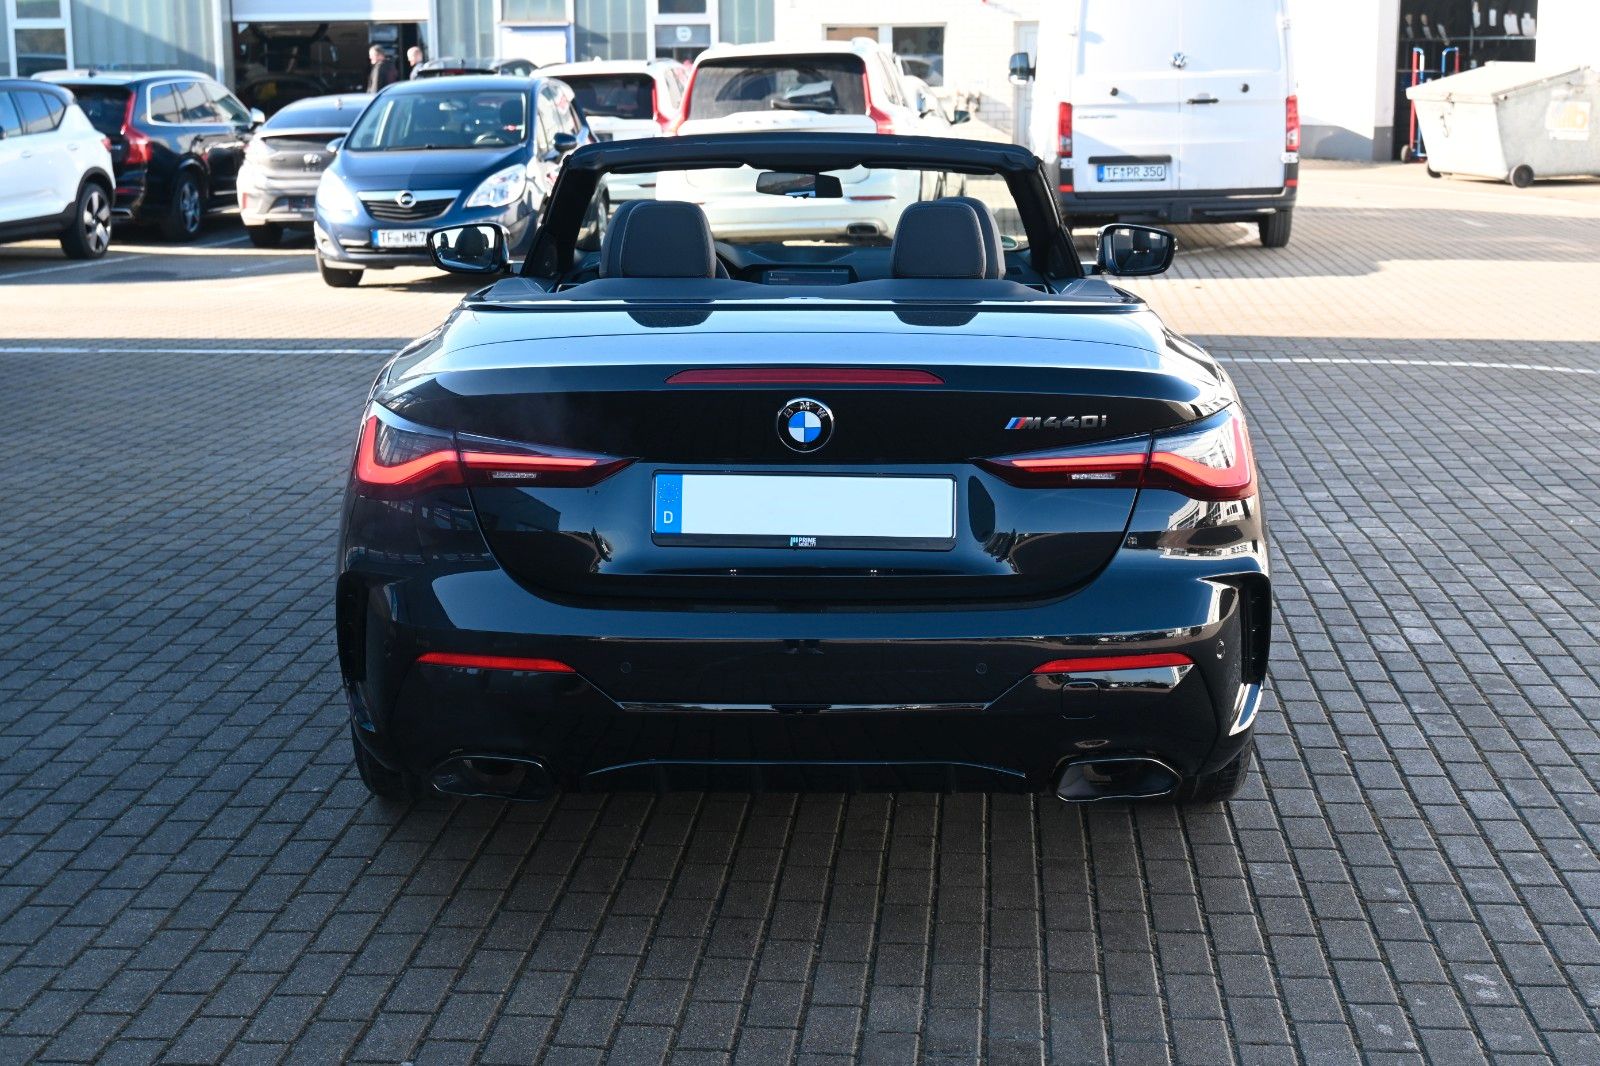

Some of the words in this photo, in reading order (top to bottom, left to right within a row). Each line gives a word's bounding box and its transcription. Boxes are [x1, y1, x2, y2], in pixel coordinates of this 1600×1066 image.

[1106, 167, 1119, 177] TF
[1126, 167, 1140, 177] PR
[1143, 167, 1163, 177] 350
[783, 401, 828, 419] BMW
[1020, 414, 1107, 430] M440i
[663, 510, 673, 524] D
